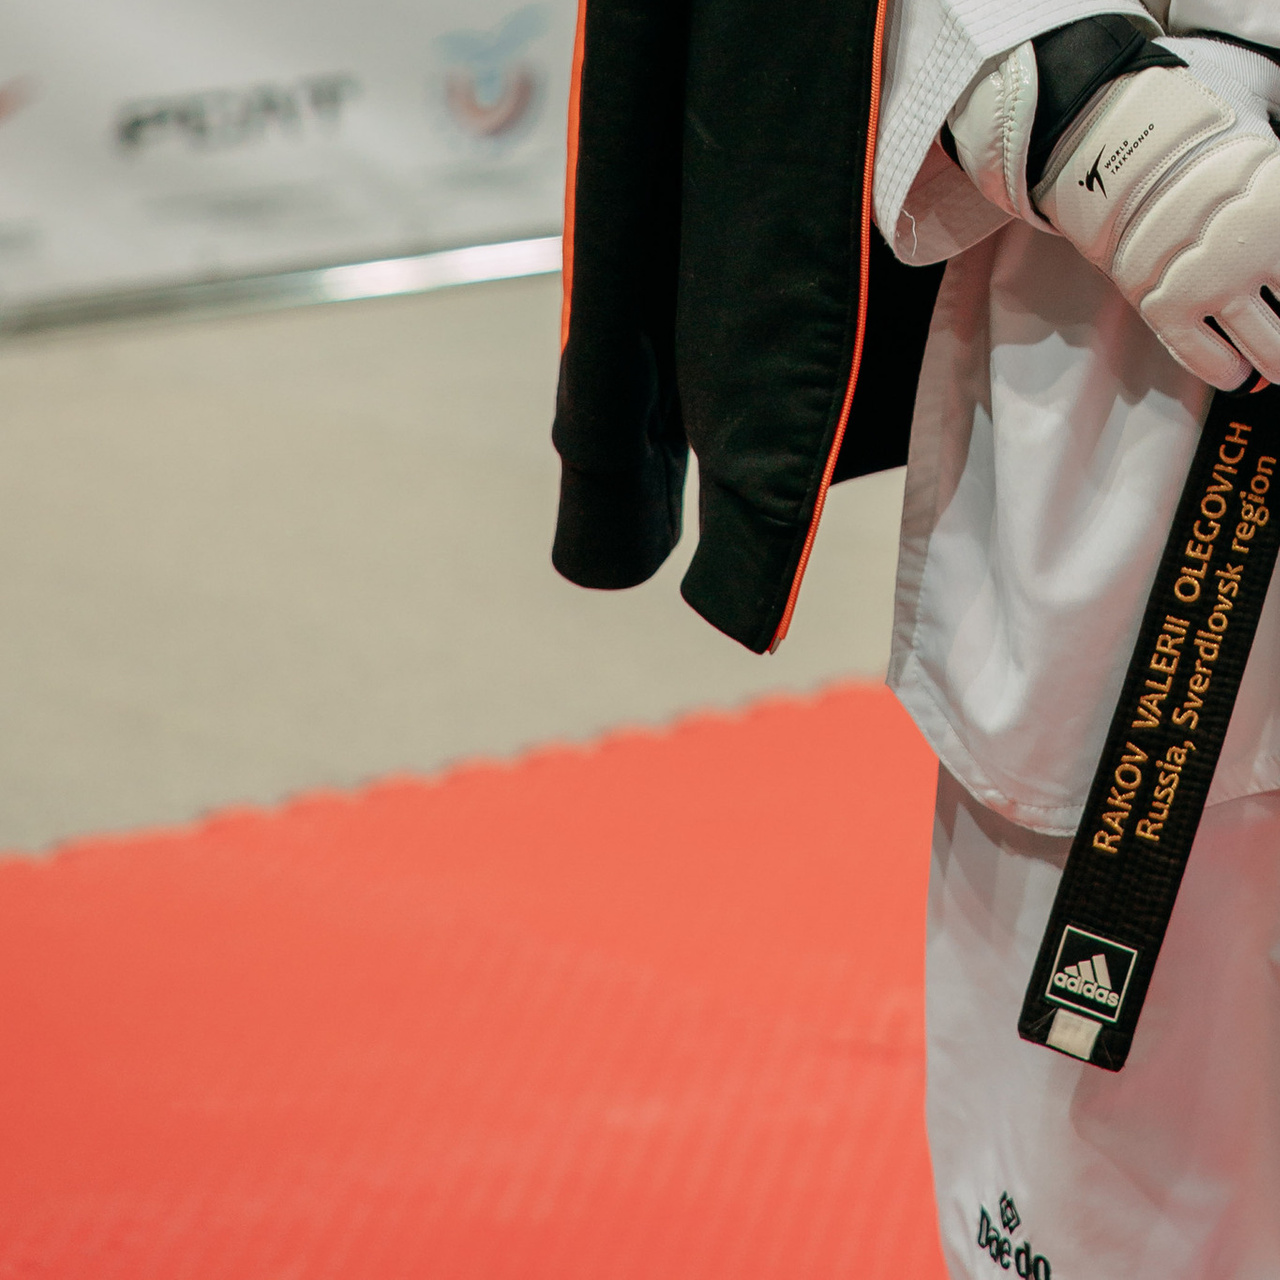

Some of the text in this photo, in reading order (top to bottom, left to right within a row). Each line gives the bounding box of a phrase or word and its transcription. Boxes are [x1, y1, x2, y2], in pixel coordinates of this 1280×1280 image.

[1103, 140, 1129, 170] WORLD
[1110, 123, 1155, 175] TAEKWONDO
[1092, 421, 1253, 854] RAKOV VALERII OLEGOVICH
[1135, 455, 1277, 841] Russia, Sverdlovsk region
[1053, 971, 1120, 1008] adidas
